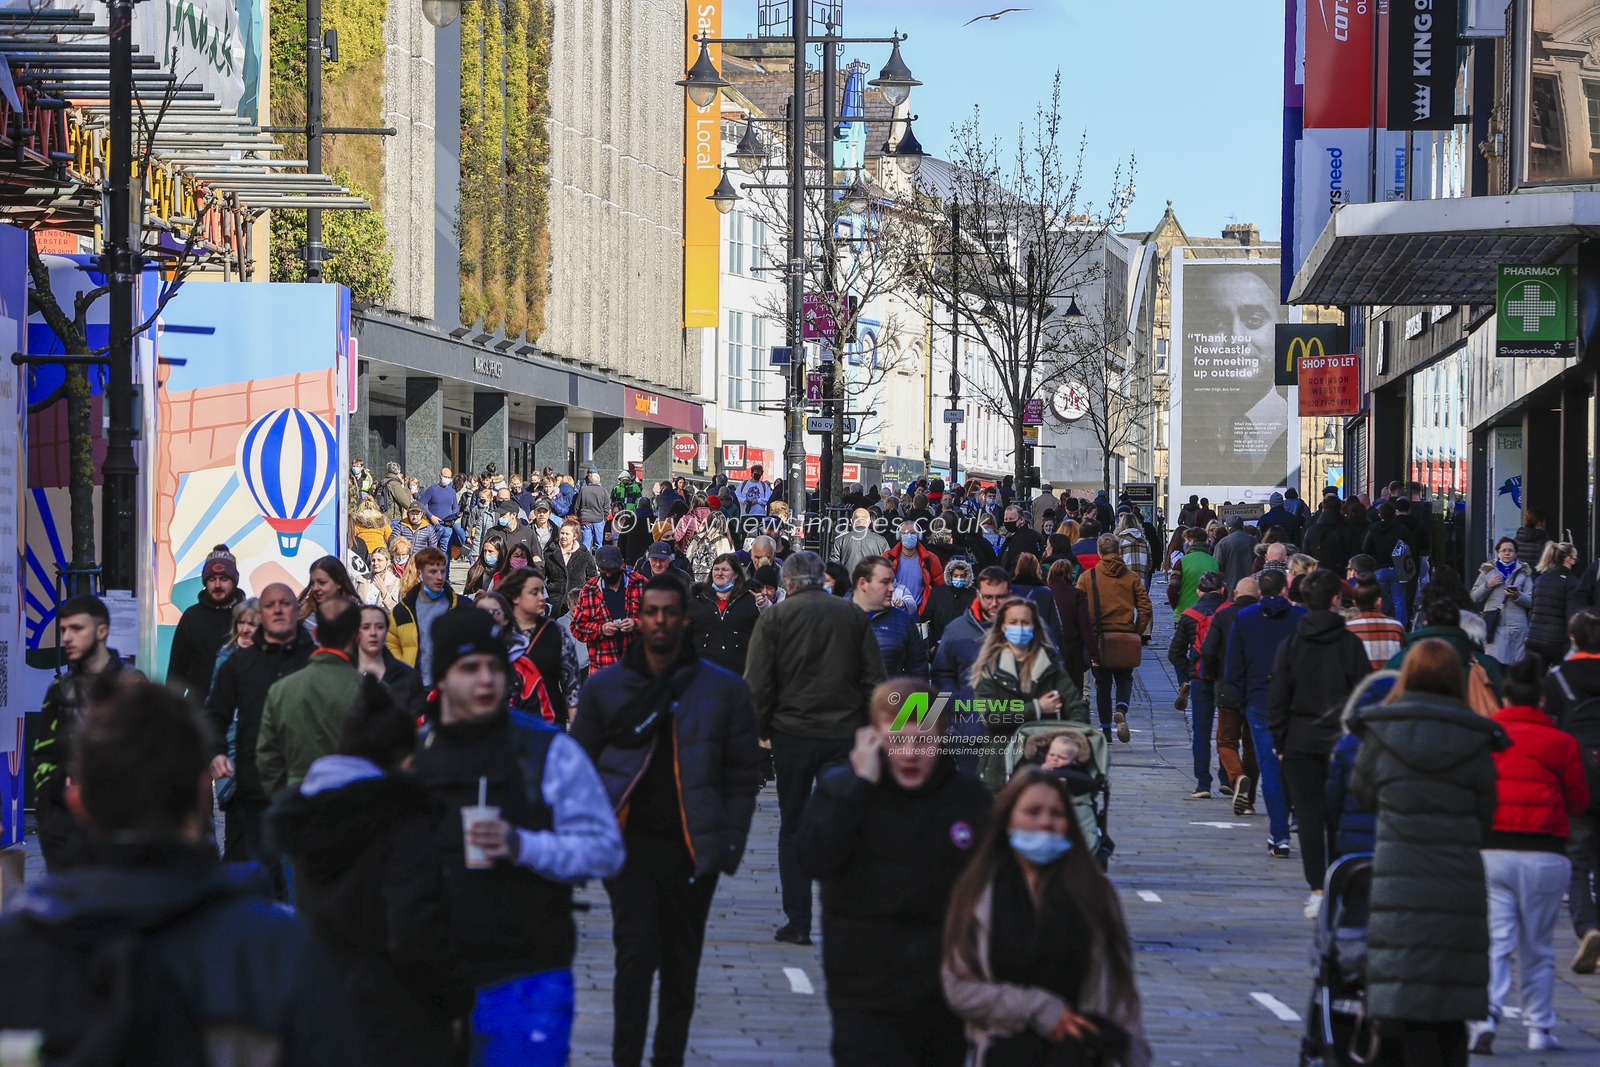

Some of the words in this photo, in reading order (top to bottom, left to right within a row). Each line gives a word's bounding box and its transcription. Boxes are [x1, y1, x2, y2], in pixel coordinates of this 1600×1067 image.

[1413, 13, 1433, 77] KING
[696, 119, 715, 170] Local
[37, 238, 68, 246] EBSTER
[1503, 267, 1562, 276] PHARMACY
[1187, 333, 1228, 343] “Thank
[1231, 334, 1252, 345] you
[1194, 345, 1252, 355] Newcastle
[1500, 346, 1557, 356] Superdrug
[1193, 357, 1210, 366] for
[1213, 358, 1259, 368] meeting
[1302, 359, 1325, 369] SHOP
[1328, 358, 1339, 367] TO
[1341, 357, 1355, 367] LET
[1193, 370, 1208, 379] up
[1309, 376, 1349, 385] ROBINSON
[1311, 387, 1346, 395] WEBSTER
[1224, 508, 1258, 516] McDonald's
